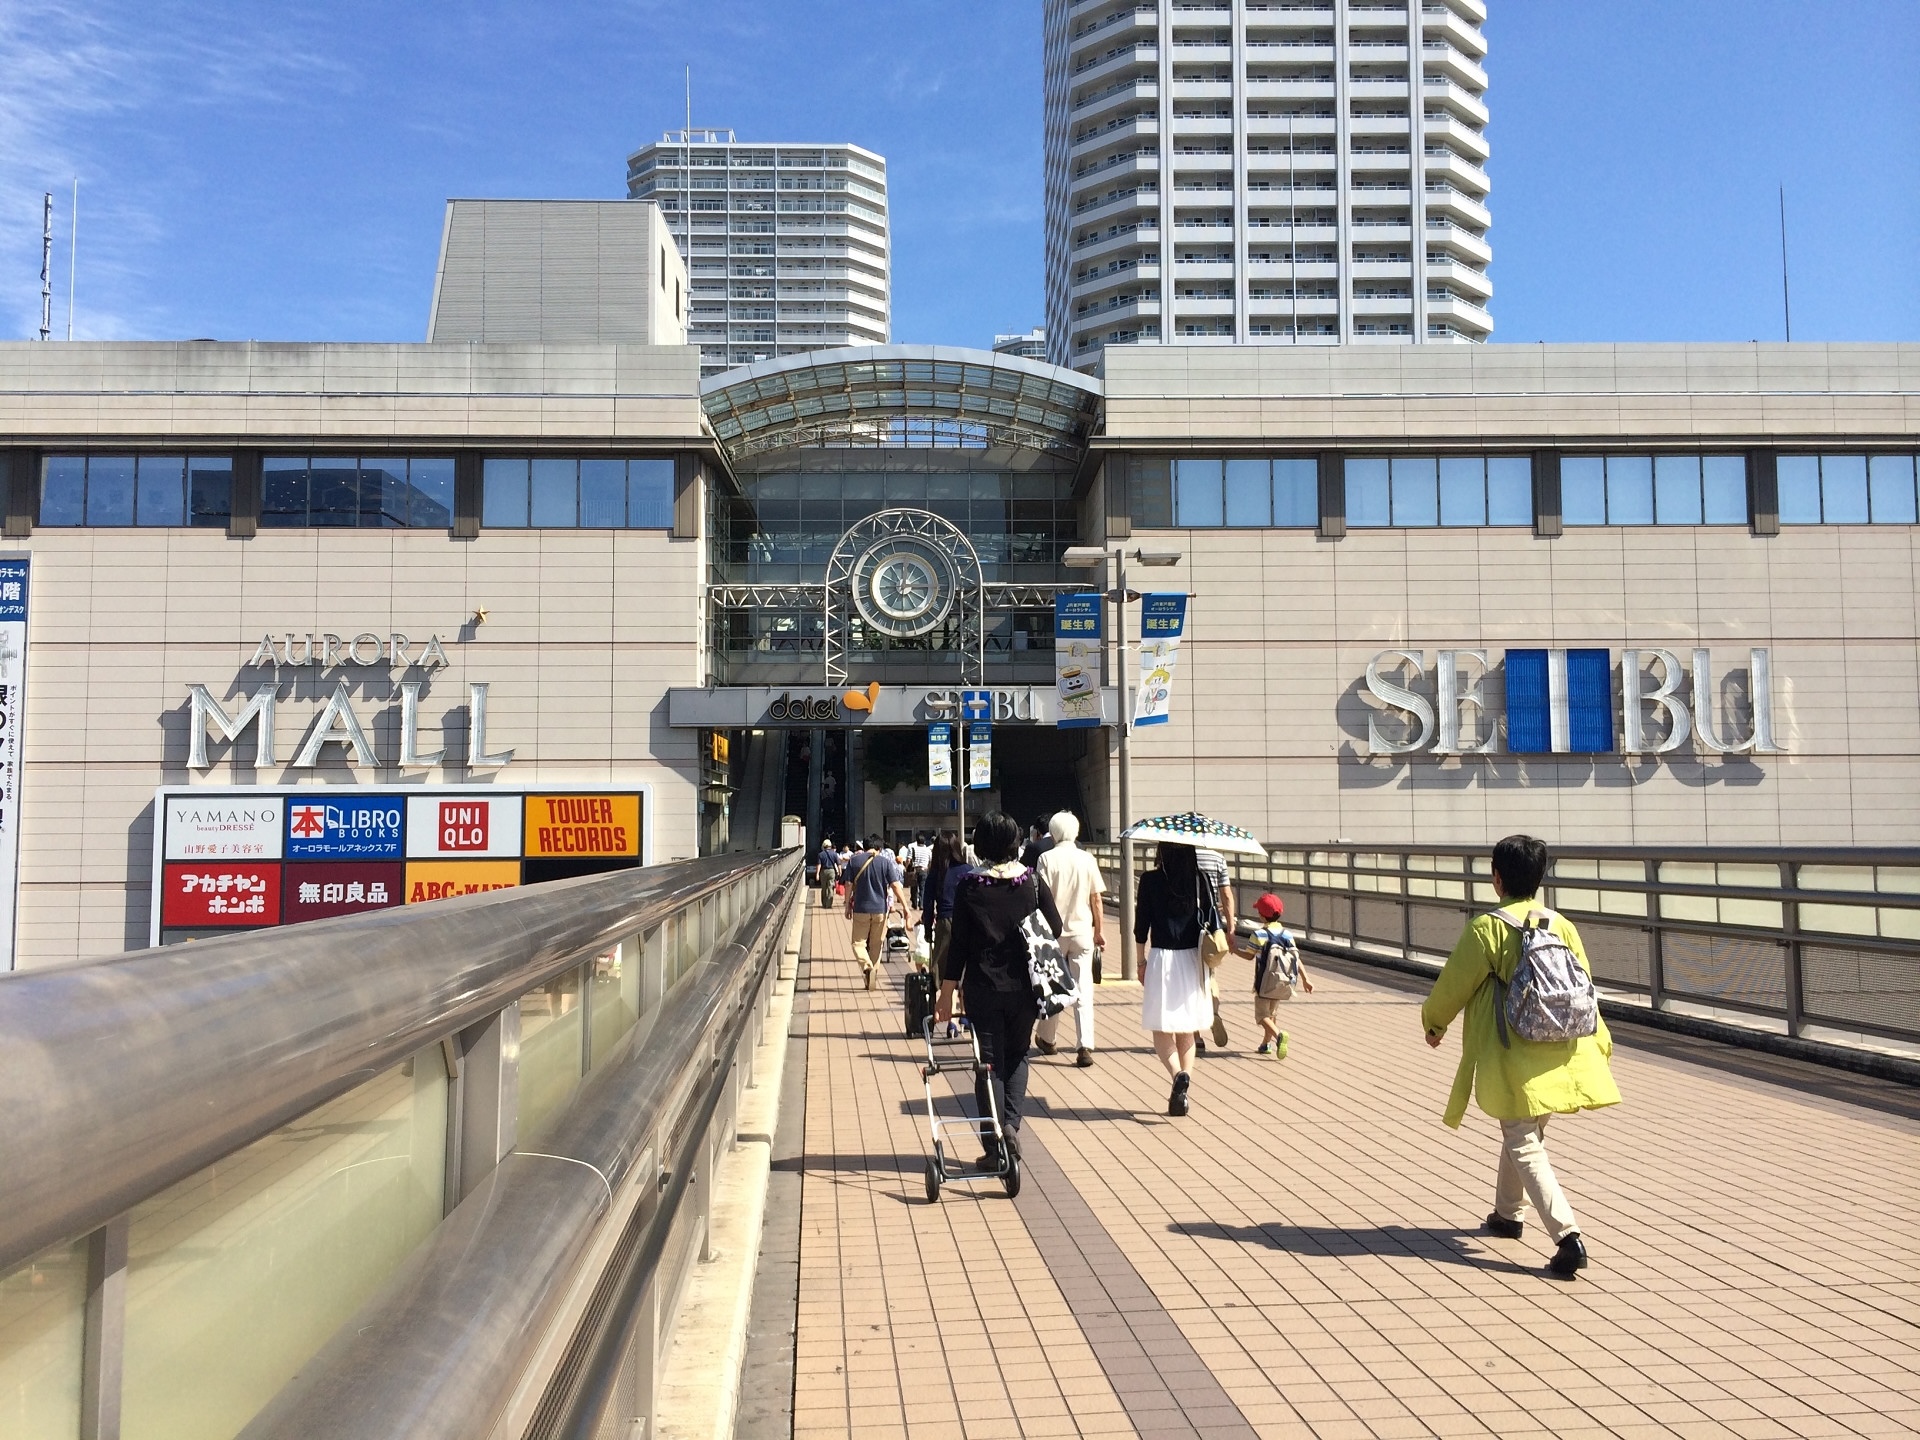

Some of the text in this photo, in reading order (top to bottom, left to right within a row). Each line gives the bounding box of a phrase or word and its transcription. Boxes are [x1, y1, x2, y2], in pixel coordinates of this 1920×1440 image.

[0, 568, 25, 578] ラモール
[0, 582, 21, 600] 階
[249, 632, 450, 667] AURORA
[769, 691, 841, 720] daiei
[1366, 648, 1788, 754] SEIBU
[185, 682, 516, 769] MALL
[176, 810, 275, 823] YAMANO
[291, 806, 323, 837] 本
[339, 809, 400, 829] LIBRO
[444, 808, 480, 825] UNI
[545, 798, 613, 824] TOWER
[338, 828, 399, 838] BOOKS
[444, 828, 483, 848] QLO
[538, 826, 627, 852] RECORDS
[292, 844, 397, 853] オーロラモールアネックス 7F
[298, 881, 388, 903] 無印良品
[410, 881, 515, 903] ABC-M
